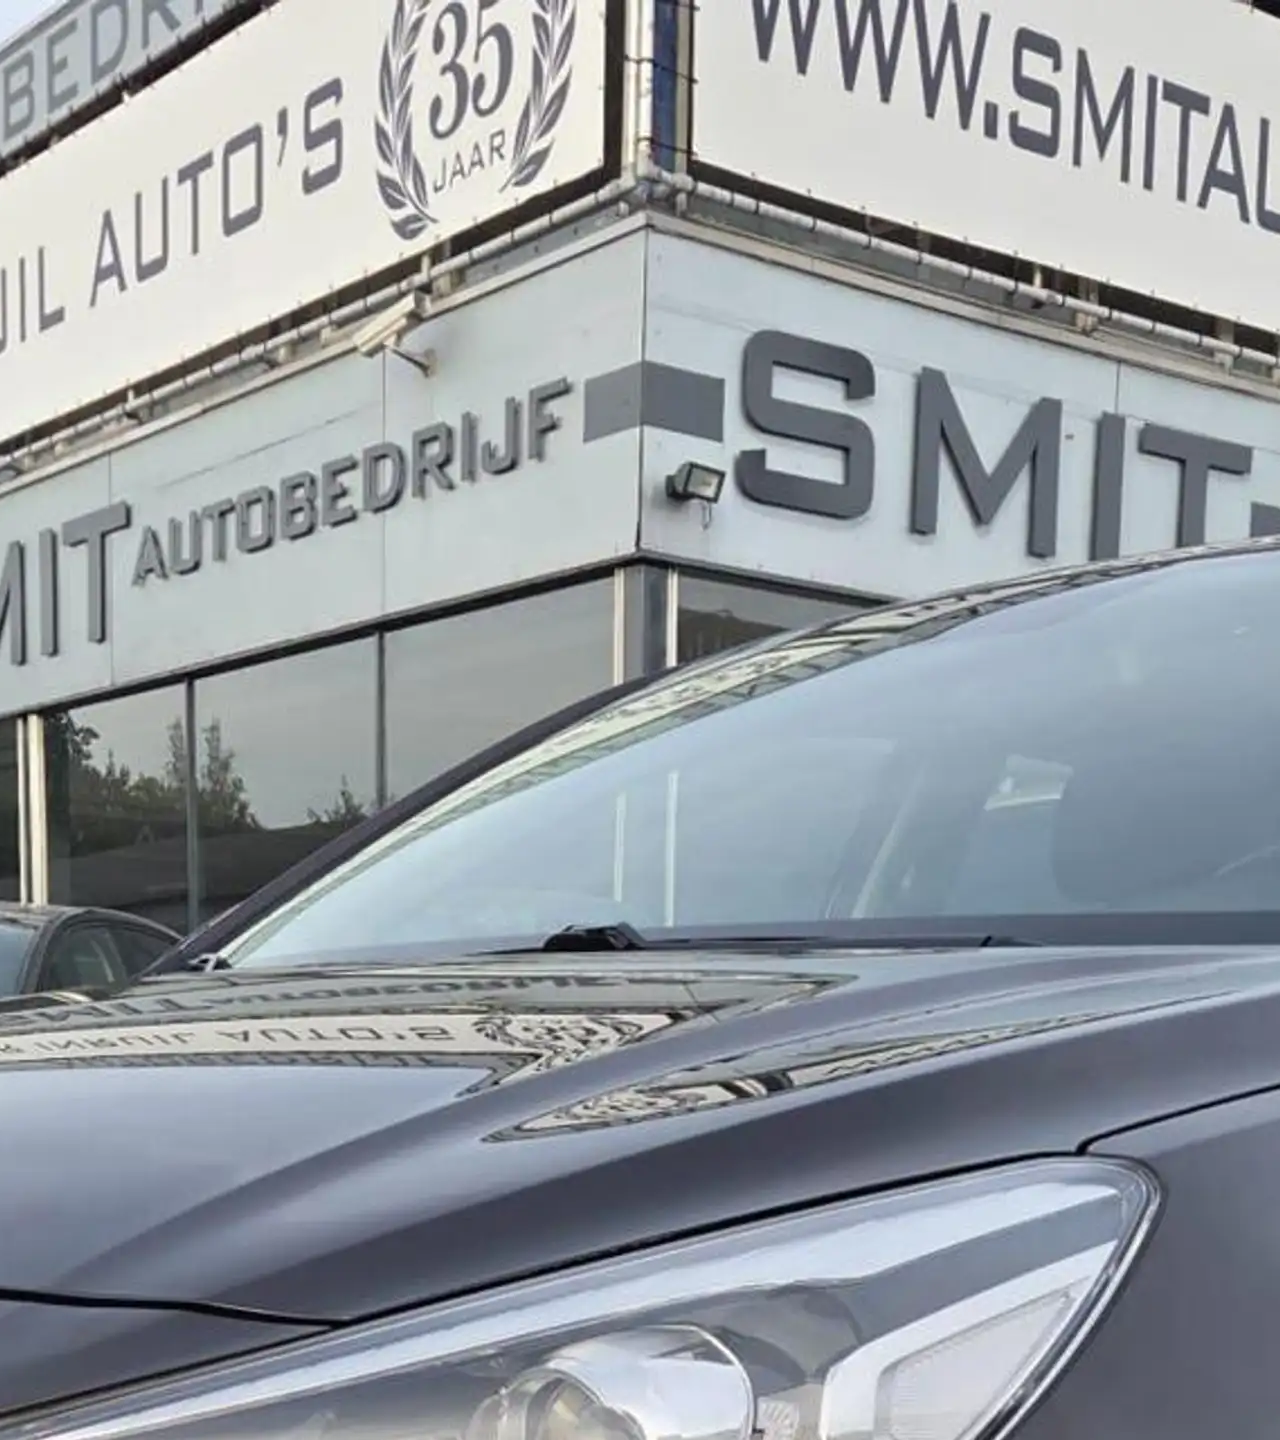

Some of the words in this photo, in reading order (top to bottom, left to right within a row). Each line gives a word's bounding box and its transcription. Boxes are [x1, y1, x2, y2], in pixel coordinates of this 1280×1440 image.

[429, 0, 515, 139] 35
[433, 125, 506, 195] JAAR
[90, 77, 344, 308] AUTO'S
[131, 377, 574, 587] AUTOBEDRIJF
[734, 329, 1254, 563] SMIT
